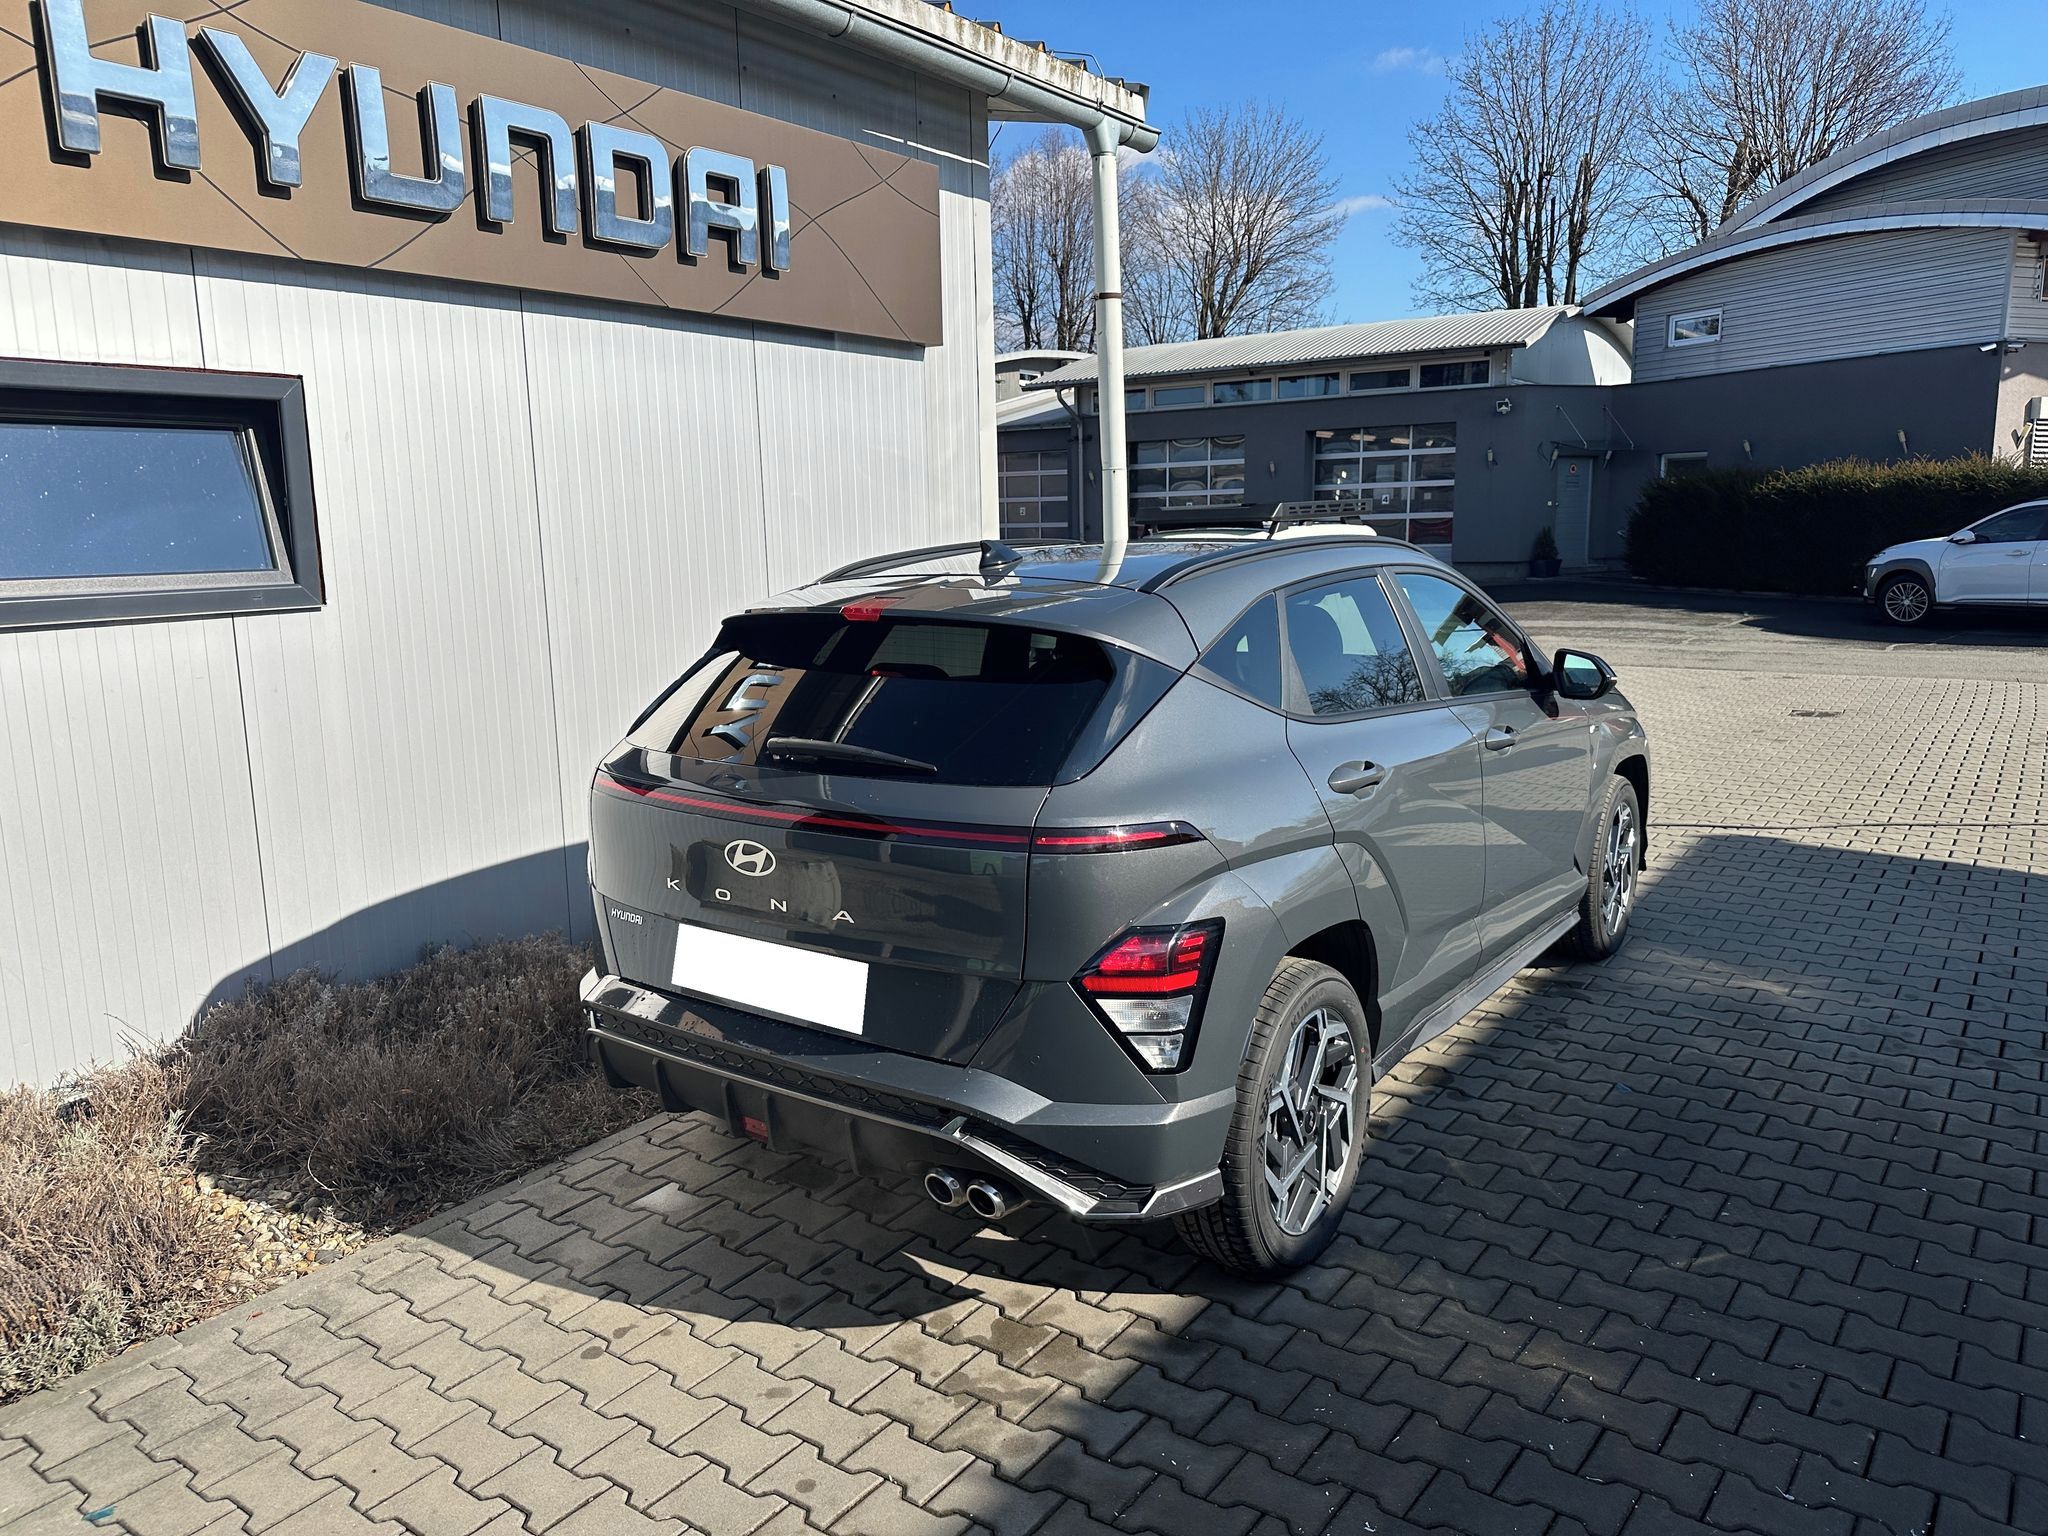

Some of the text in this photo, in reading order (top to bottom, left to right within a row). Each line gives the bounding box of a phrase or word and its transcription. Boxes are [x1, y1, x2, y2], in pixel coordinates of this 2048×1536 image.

[36, 0, 792, 274] HYUNDAI
[1382, 495, 1389, 503] 4
[611, 907, 643, 925] HYUNDAI
[666, 877, 855, 924] KONA
